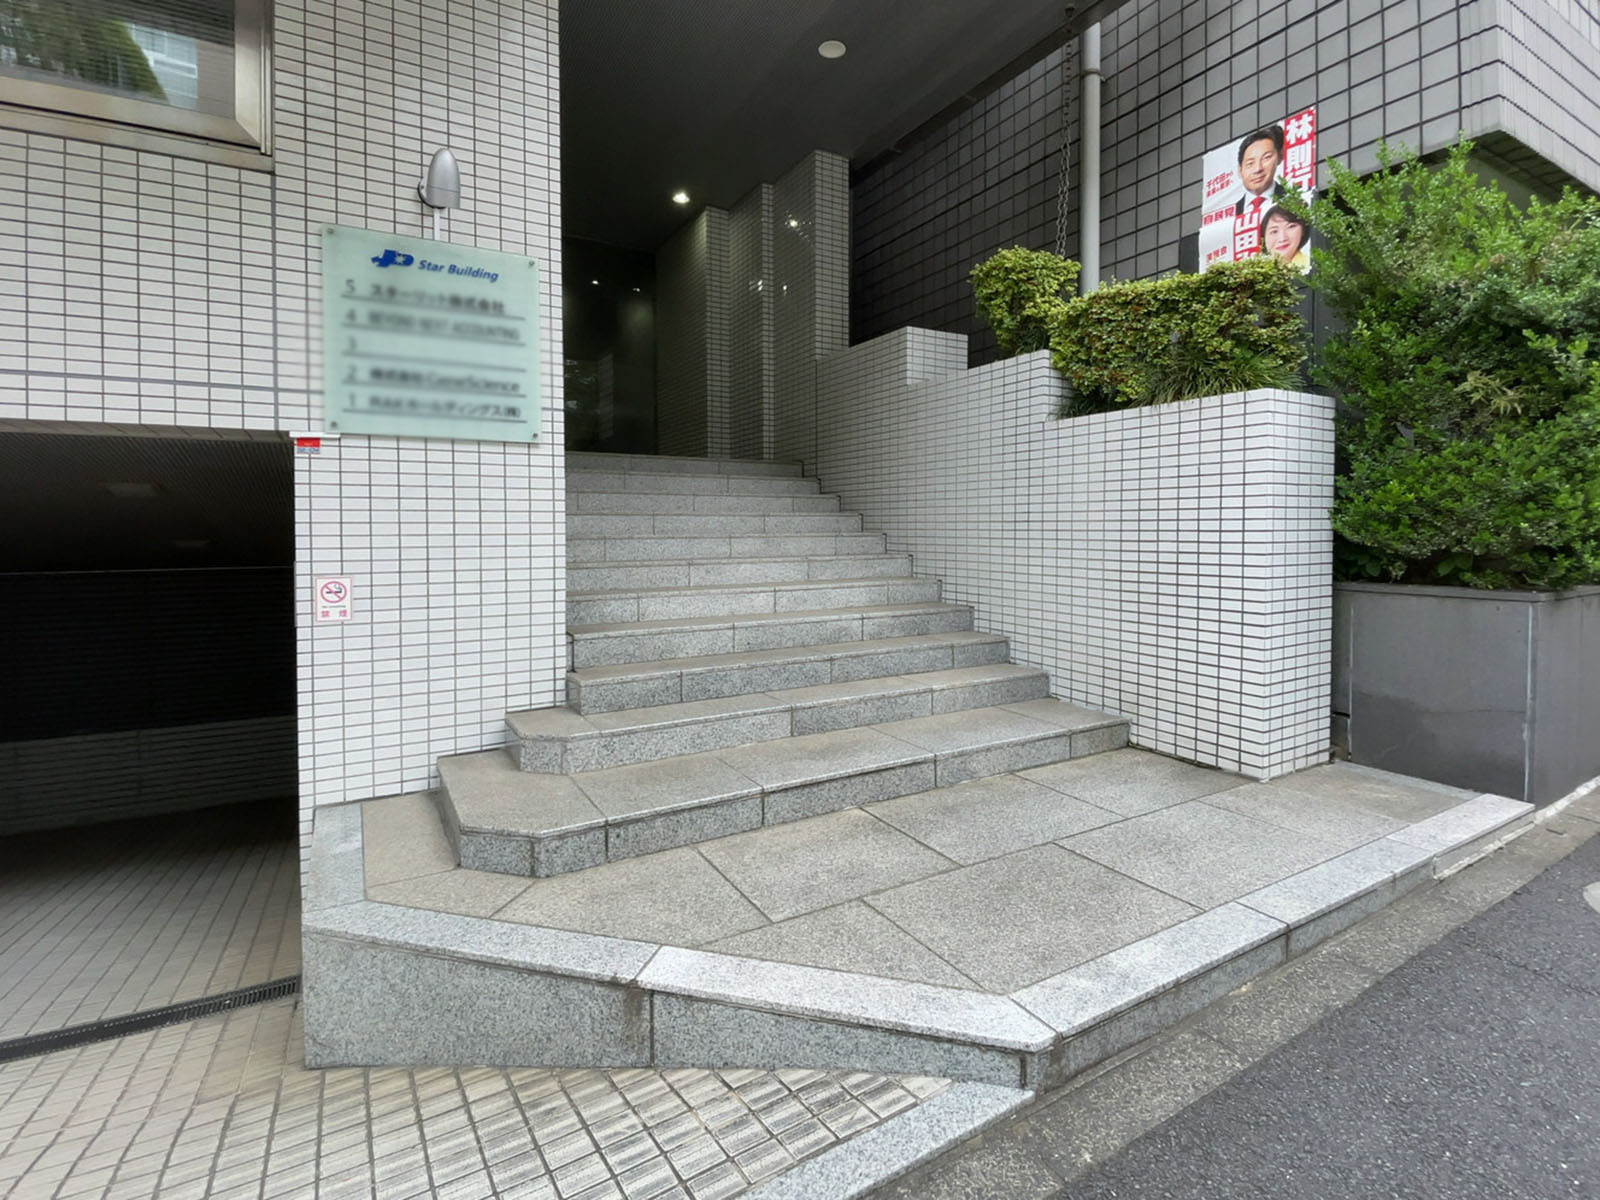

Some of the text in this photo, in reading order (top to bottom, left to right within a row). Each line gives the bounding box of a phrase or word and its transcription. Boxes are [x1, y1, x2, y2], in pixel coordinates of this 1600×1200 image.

[1285, 113, 1312, 192] 林則行
[1203, 206, 1235, 226] 自民党
[418, 259, 499, 284] Star Building
[345, 279, 355, 294] 5
